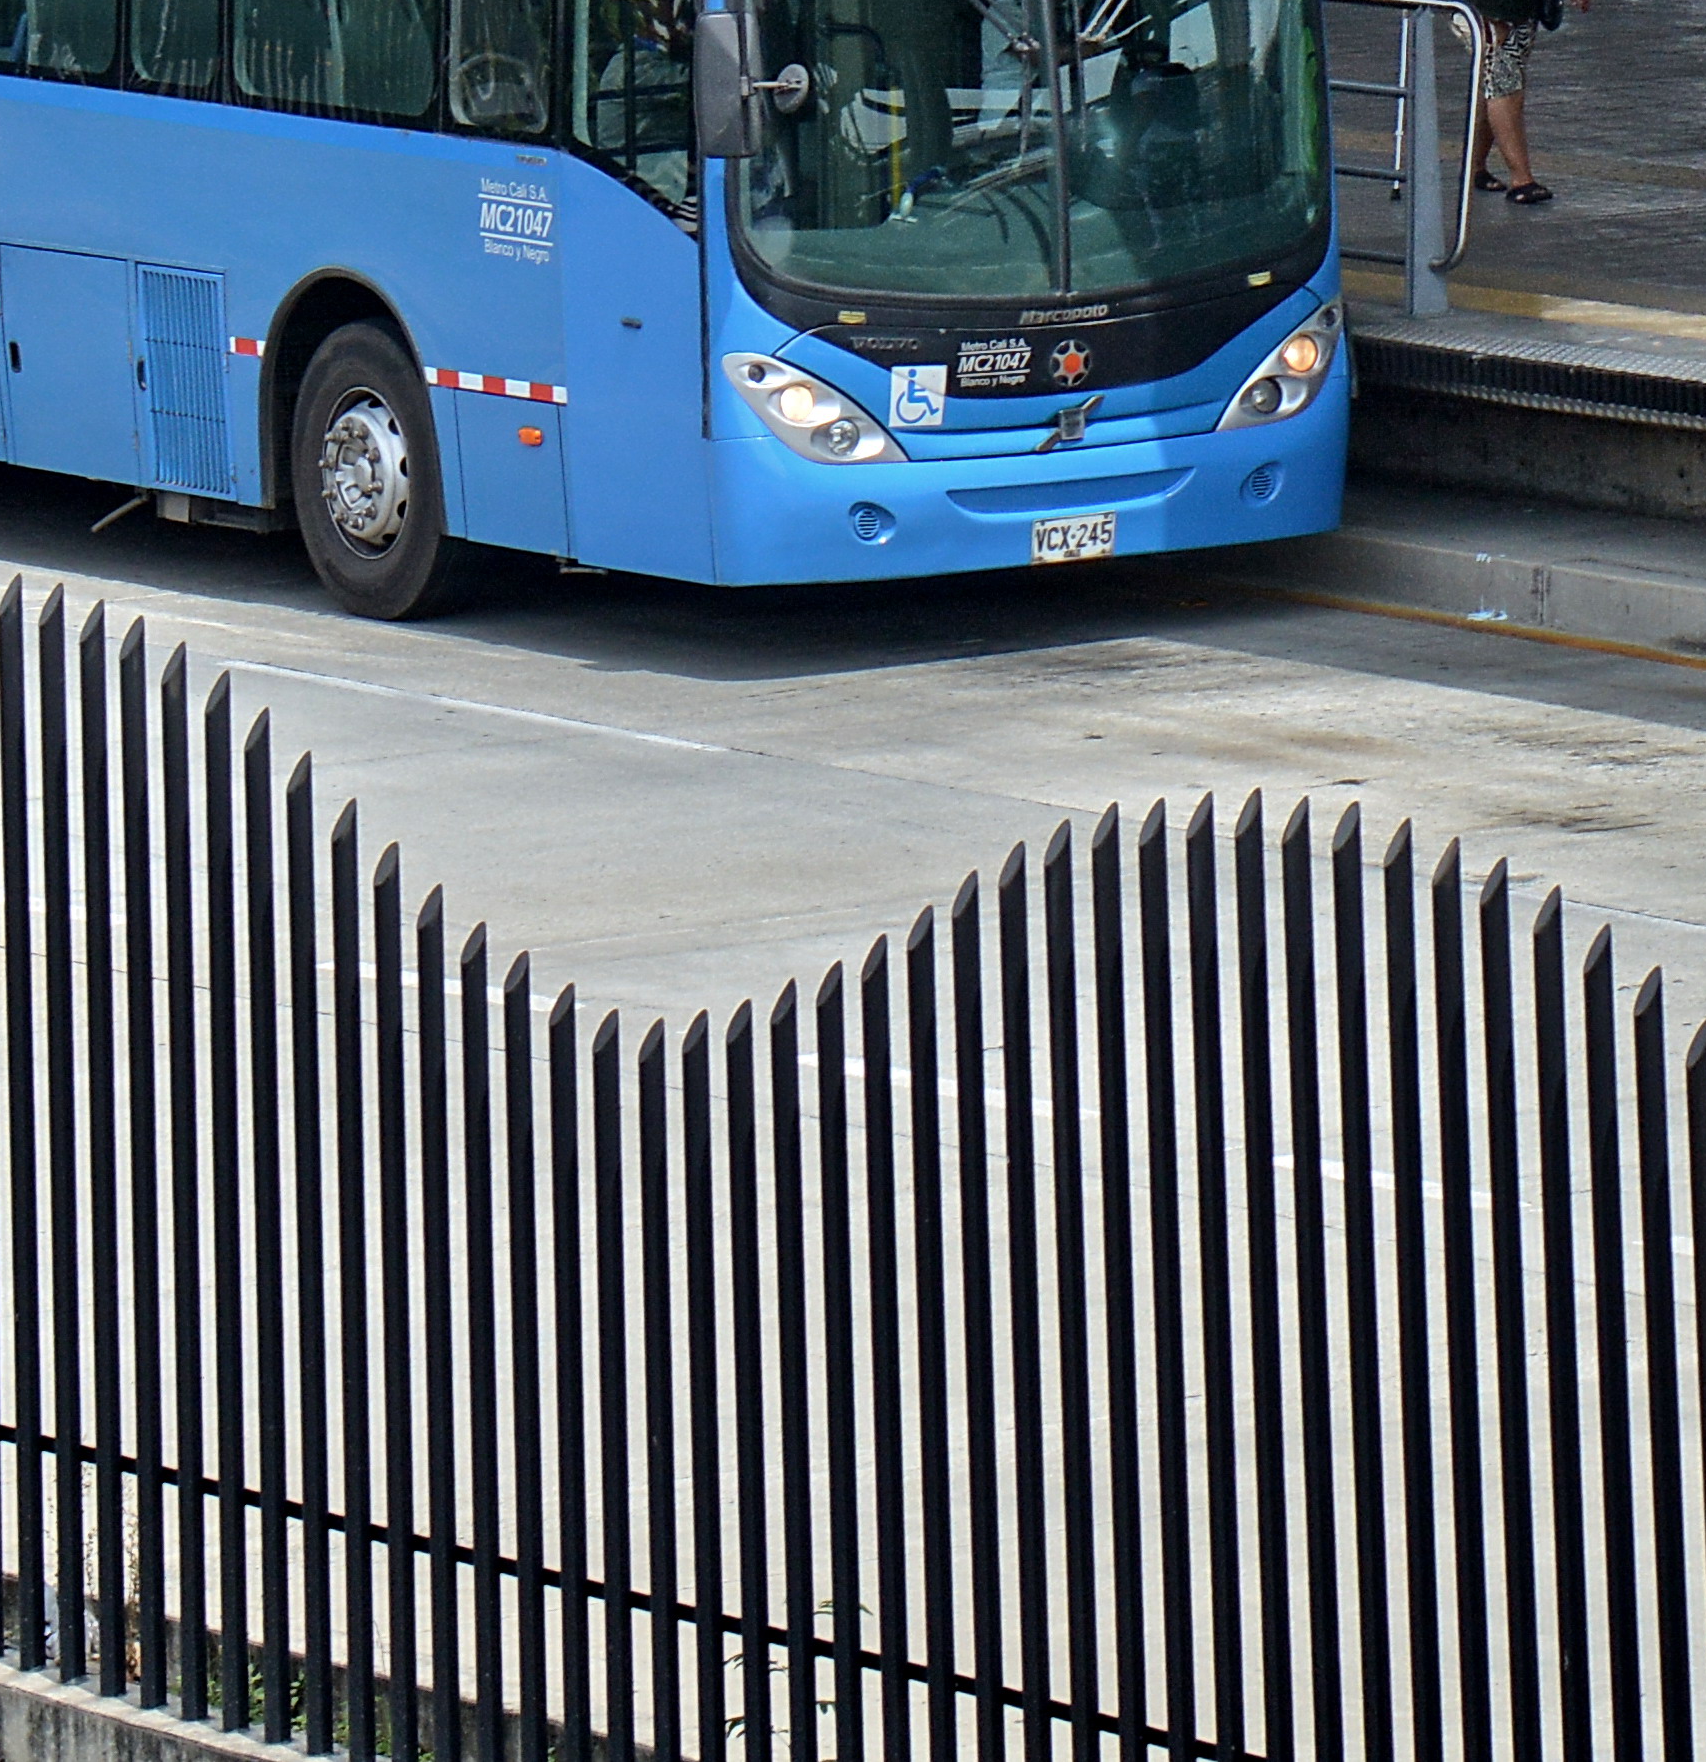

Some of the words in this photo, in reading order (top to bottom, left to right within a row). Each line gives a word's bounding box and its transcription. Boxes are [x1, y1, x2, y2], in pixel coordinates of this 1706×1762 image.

[480, 177, 508, 196] Metro
[509, 181, 527, 198] Cali
[479, 202, 553, 238] MC21047
[484, 238, 514, 257] Blanco
[515, 247, 522, 262] y
[522, 244, 550, 265] Negro
[1019, 304, 1109, 325] Marcopolo
[961, 341, 988, 353] Metro
[989, 340, 1007, 351] Cali
[957, 351, 1031, 374] MC21047
[960, 376, 991, 388] Blanco
[991, 377, 998, 387] y
[998, 374, 1026, 386] Negro
